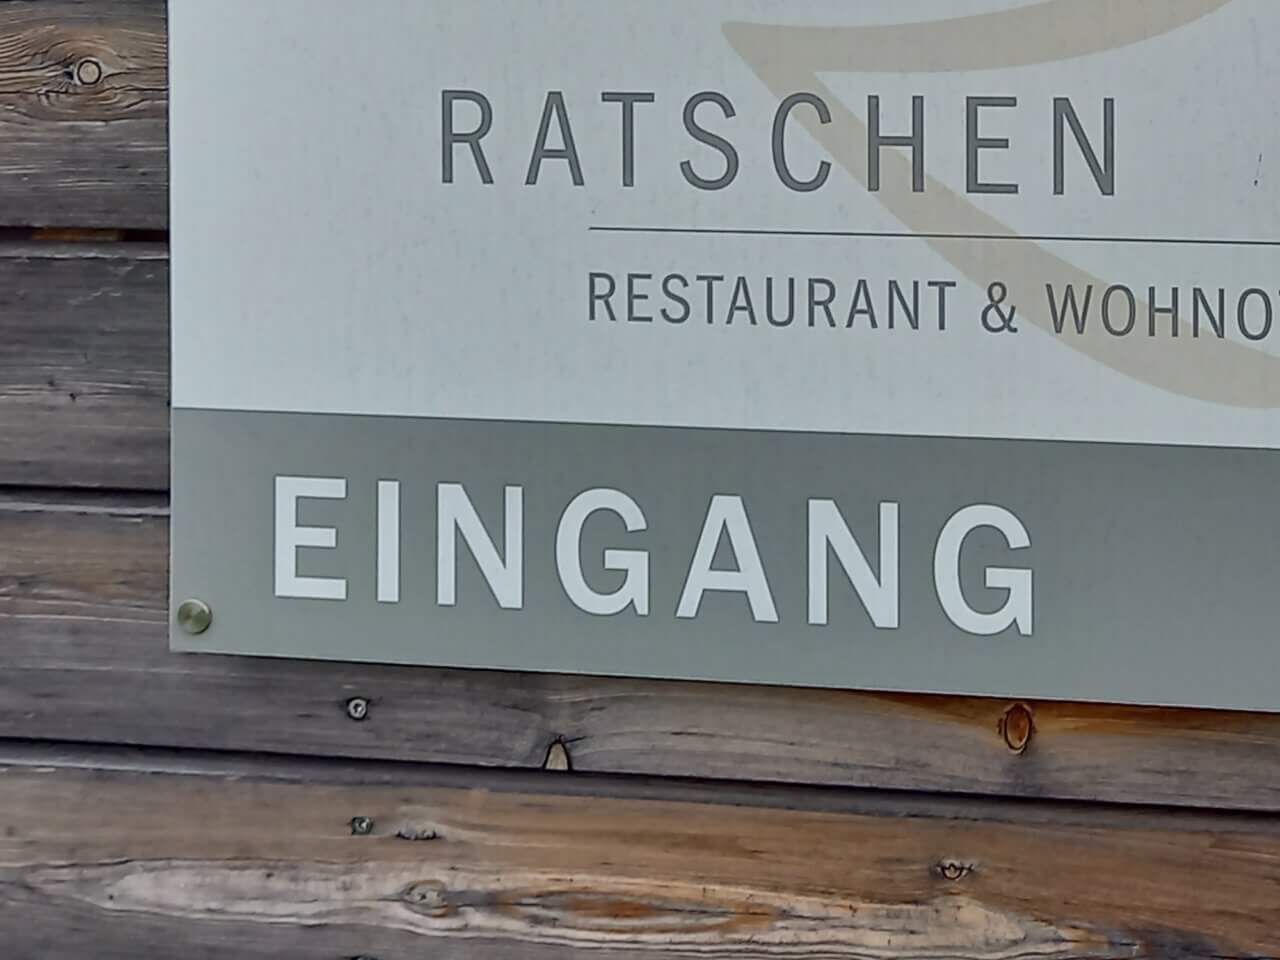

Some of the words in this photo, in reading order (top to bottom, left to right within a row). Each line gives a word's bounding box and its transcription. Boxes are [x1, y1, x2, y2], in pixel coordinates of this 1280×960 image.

[440, 88, 1117, 198] RATSCHEN
[588, 271, 957, 332] RESTAURANT
[980, 281, 1019, 334] &
[273, 475, 1035, 637] EINGANG
